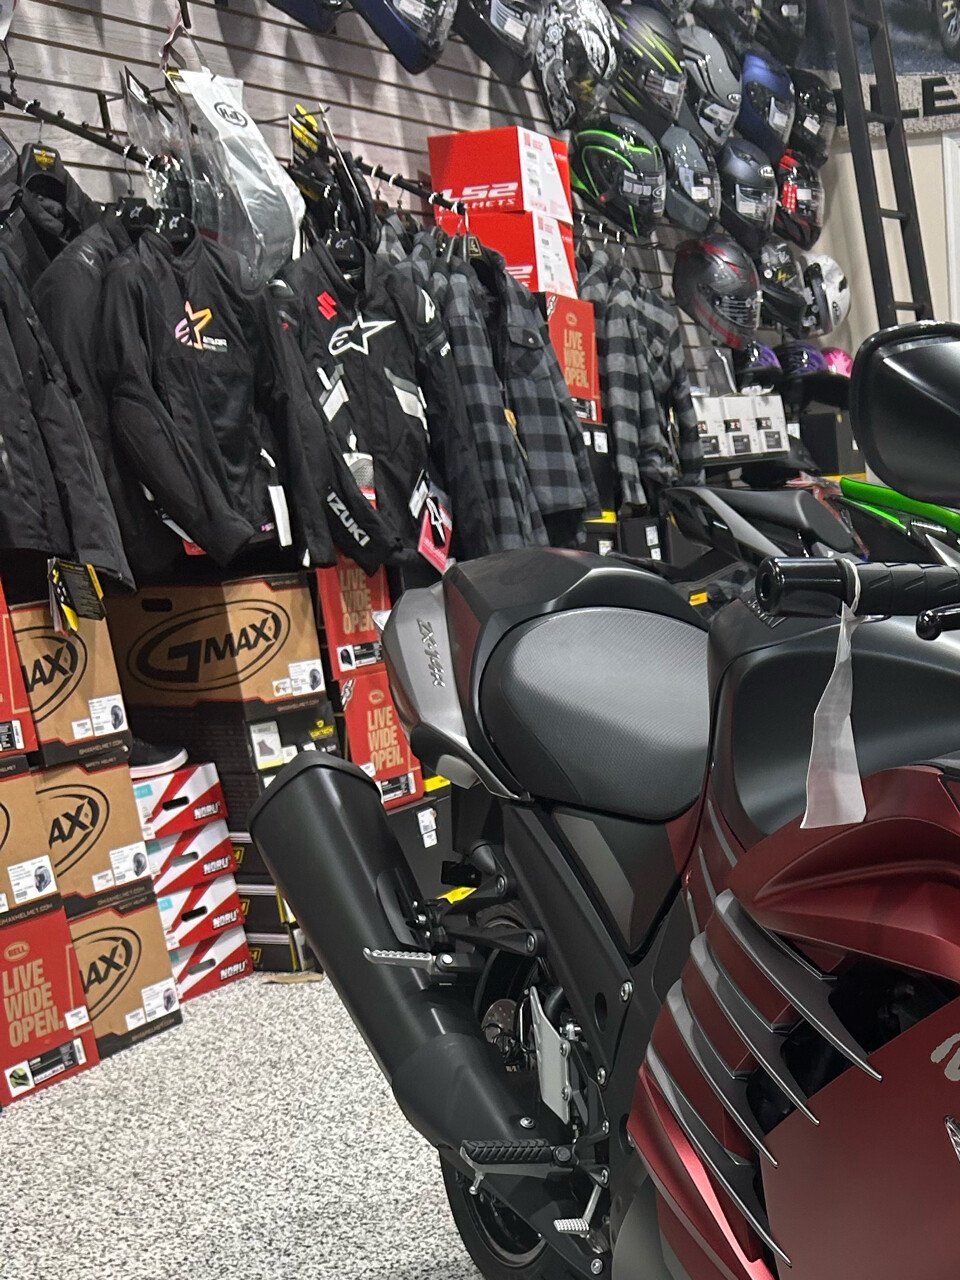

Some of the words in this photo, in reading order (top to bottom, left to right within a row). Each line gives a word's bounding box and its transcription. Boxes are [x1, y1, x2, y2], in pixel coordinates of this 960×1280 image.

[442, 182, 518, 202] LS2
[564, 329, 582, 350] LIVE
[136, 612, 274, 684] GMAX
[367, 706, 393, 732] LIVE
[368, 725, 398, 752] WIDE
[3, 958, 45, 997] LIVE
[4, 982, 54, 1022] WIDE
[9, 1006, 64, 1048] OPEN.
